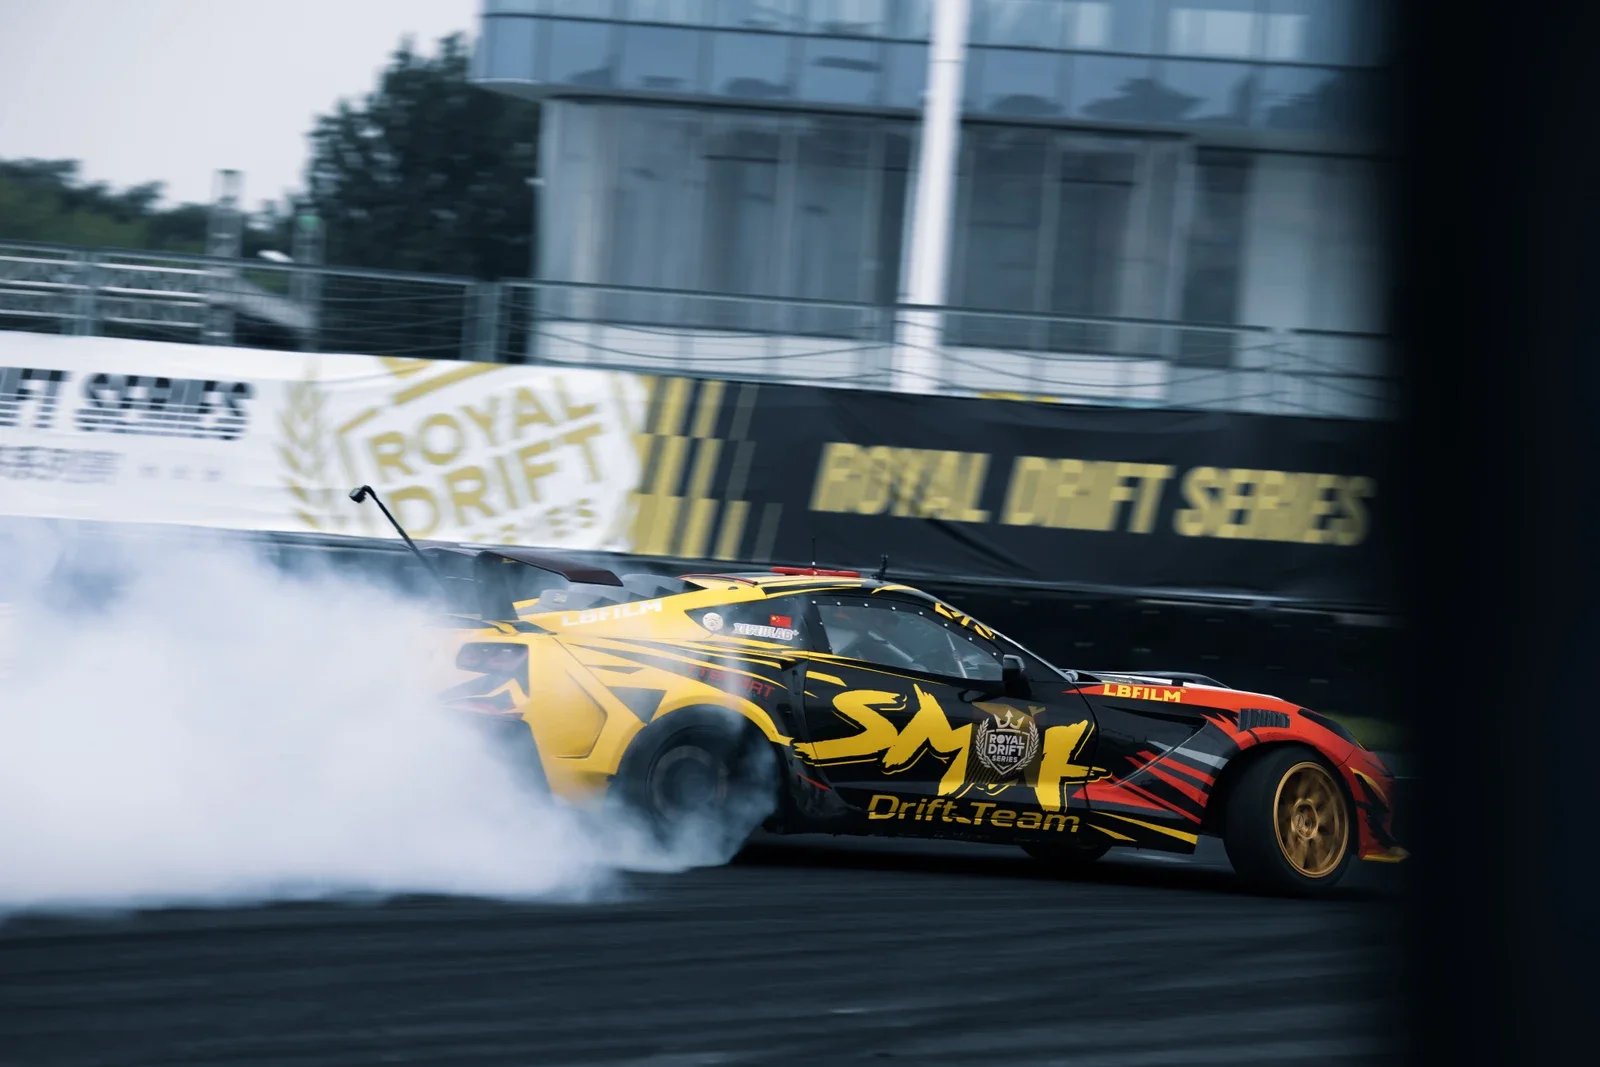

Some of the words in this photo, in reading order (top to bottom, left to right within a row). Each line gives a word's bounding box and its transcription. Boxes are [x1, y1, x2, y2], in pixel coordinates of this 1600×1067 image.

[77, 374, 254, 439] SERIES
[369, 378, 597, 482] ROYAL
[389, 424, 603, 537] DRIFT
[811, 443, 990, 522] ROYAL
[999, 456, 1176, 534] DRIFT
[1174, 467, 1375, 545] SERIES
[562, 599, 662, 626] LBFILM
[988, 744, 1025, 756] DRIFT
[989, 734, 1025, 745] ROYAL
[991, 754, 1018, 763] SERIES
[970, 802, 1080, 833] Team
